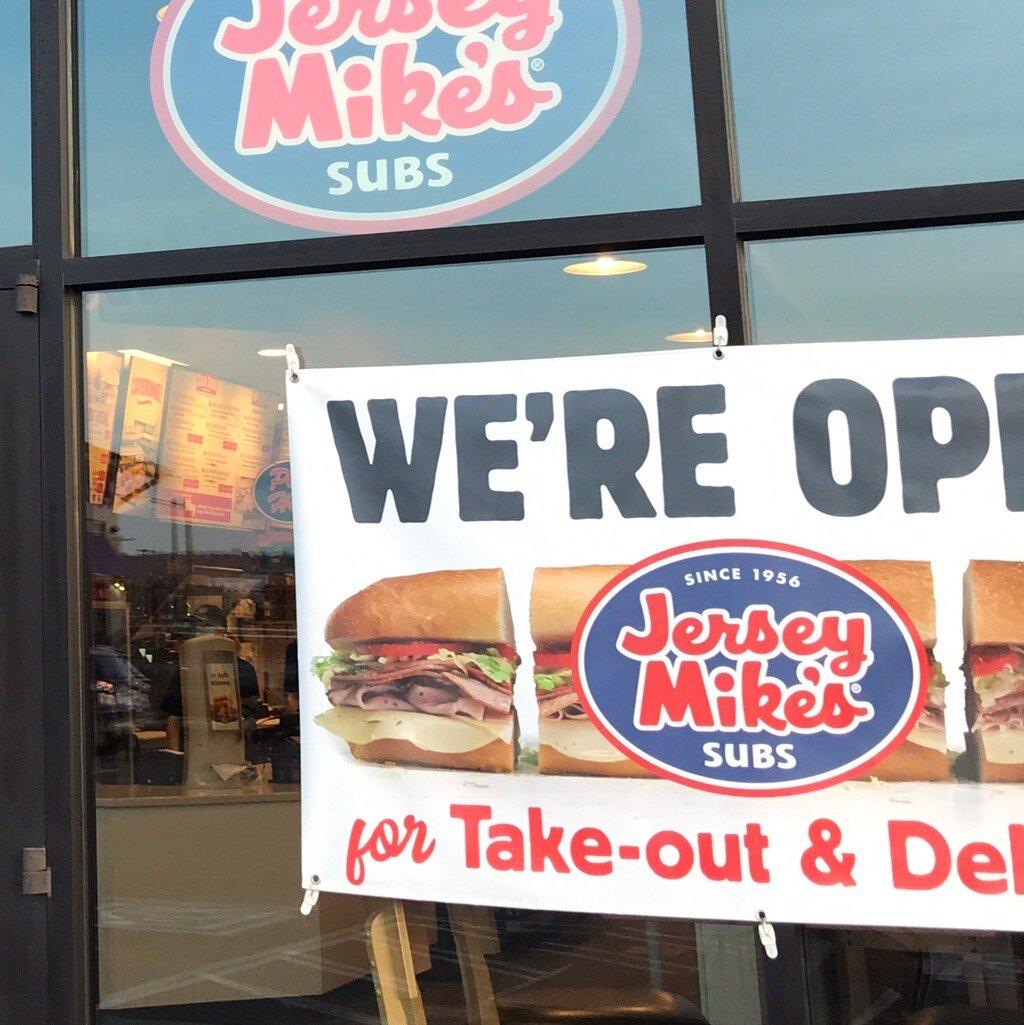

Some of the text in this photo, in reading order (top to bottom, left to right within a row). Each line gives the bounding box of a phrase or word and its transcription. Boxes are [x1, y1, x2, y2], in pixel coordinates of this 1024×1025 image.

[238, 39, 557, 152] Mike's
[326, 152, 454, 196] SUBS
[326, 383, 737, 524] WE'RE
[683, 567, 802, 588] SINCE 1956
[621, 591, 869, 678] Jersey
[636, 660, 869, 733] Mike's
[702, 742, 797, 769] SUBS
[345, 812, 437, 885] for
[450, 804, 771, 884] Take-out
[800, 818, 857, 888] &
